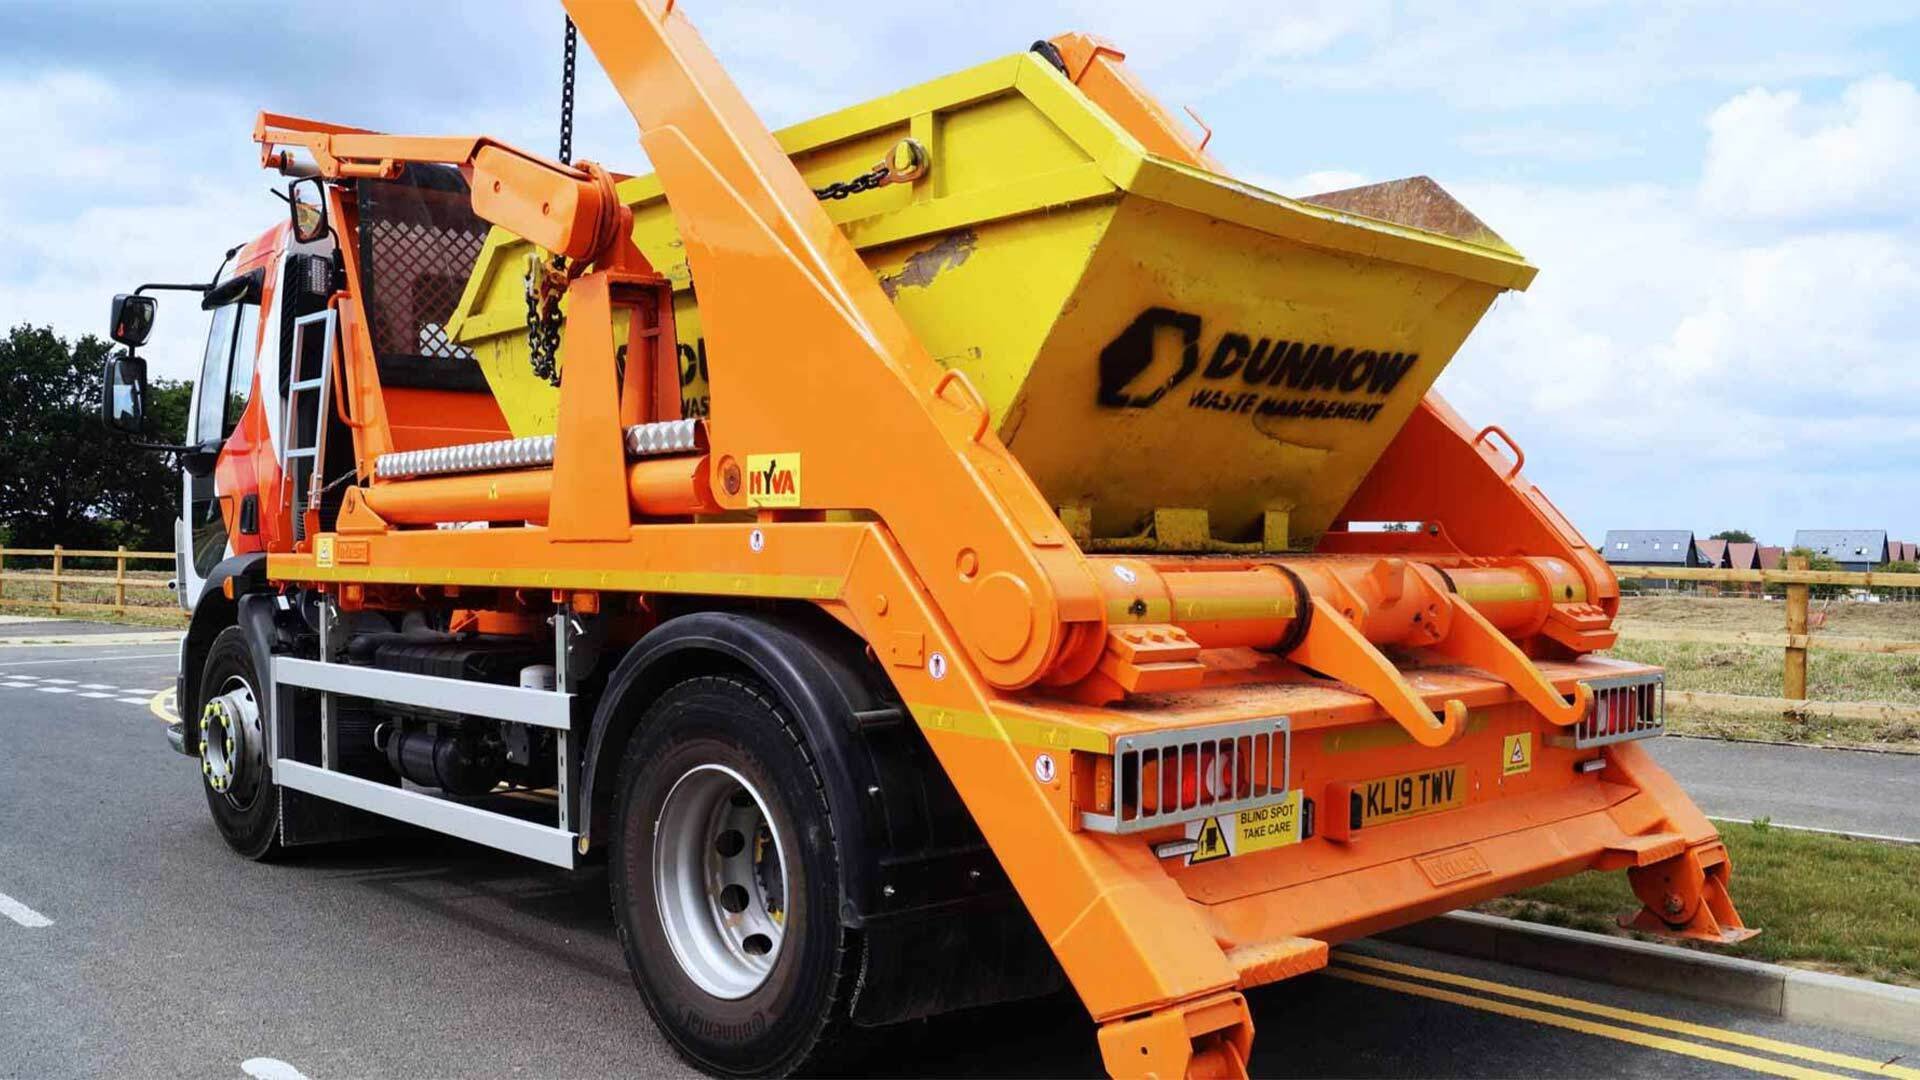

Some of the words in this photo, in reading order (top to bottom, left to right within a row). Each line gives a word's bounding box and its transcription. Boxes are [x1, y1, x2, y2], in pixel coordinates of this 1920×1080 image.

[1203, 333, 1418, 395] DUNMOW
[1188, 388, 1256, 414] WASTE
[1256, 394, 1384, 422] MANAGEMENT
[749, 459, 796, 495] HYVA
[1366, 777, 1413, 818] KL19
[1419, 769, 1456, 807] TWV
[1240, 808, 1268, 825] BLIND
[1270, 803, 1295, 819] SPOT
[1243, 825, 1266, 839] TAKE
[1267, 820, 1292, 835] CARE
